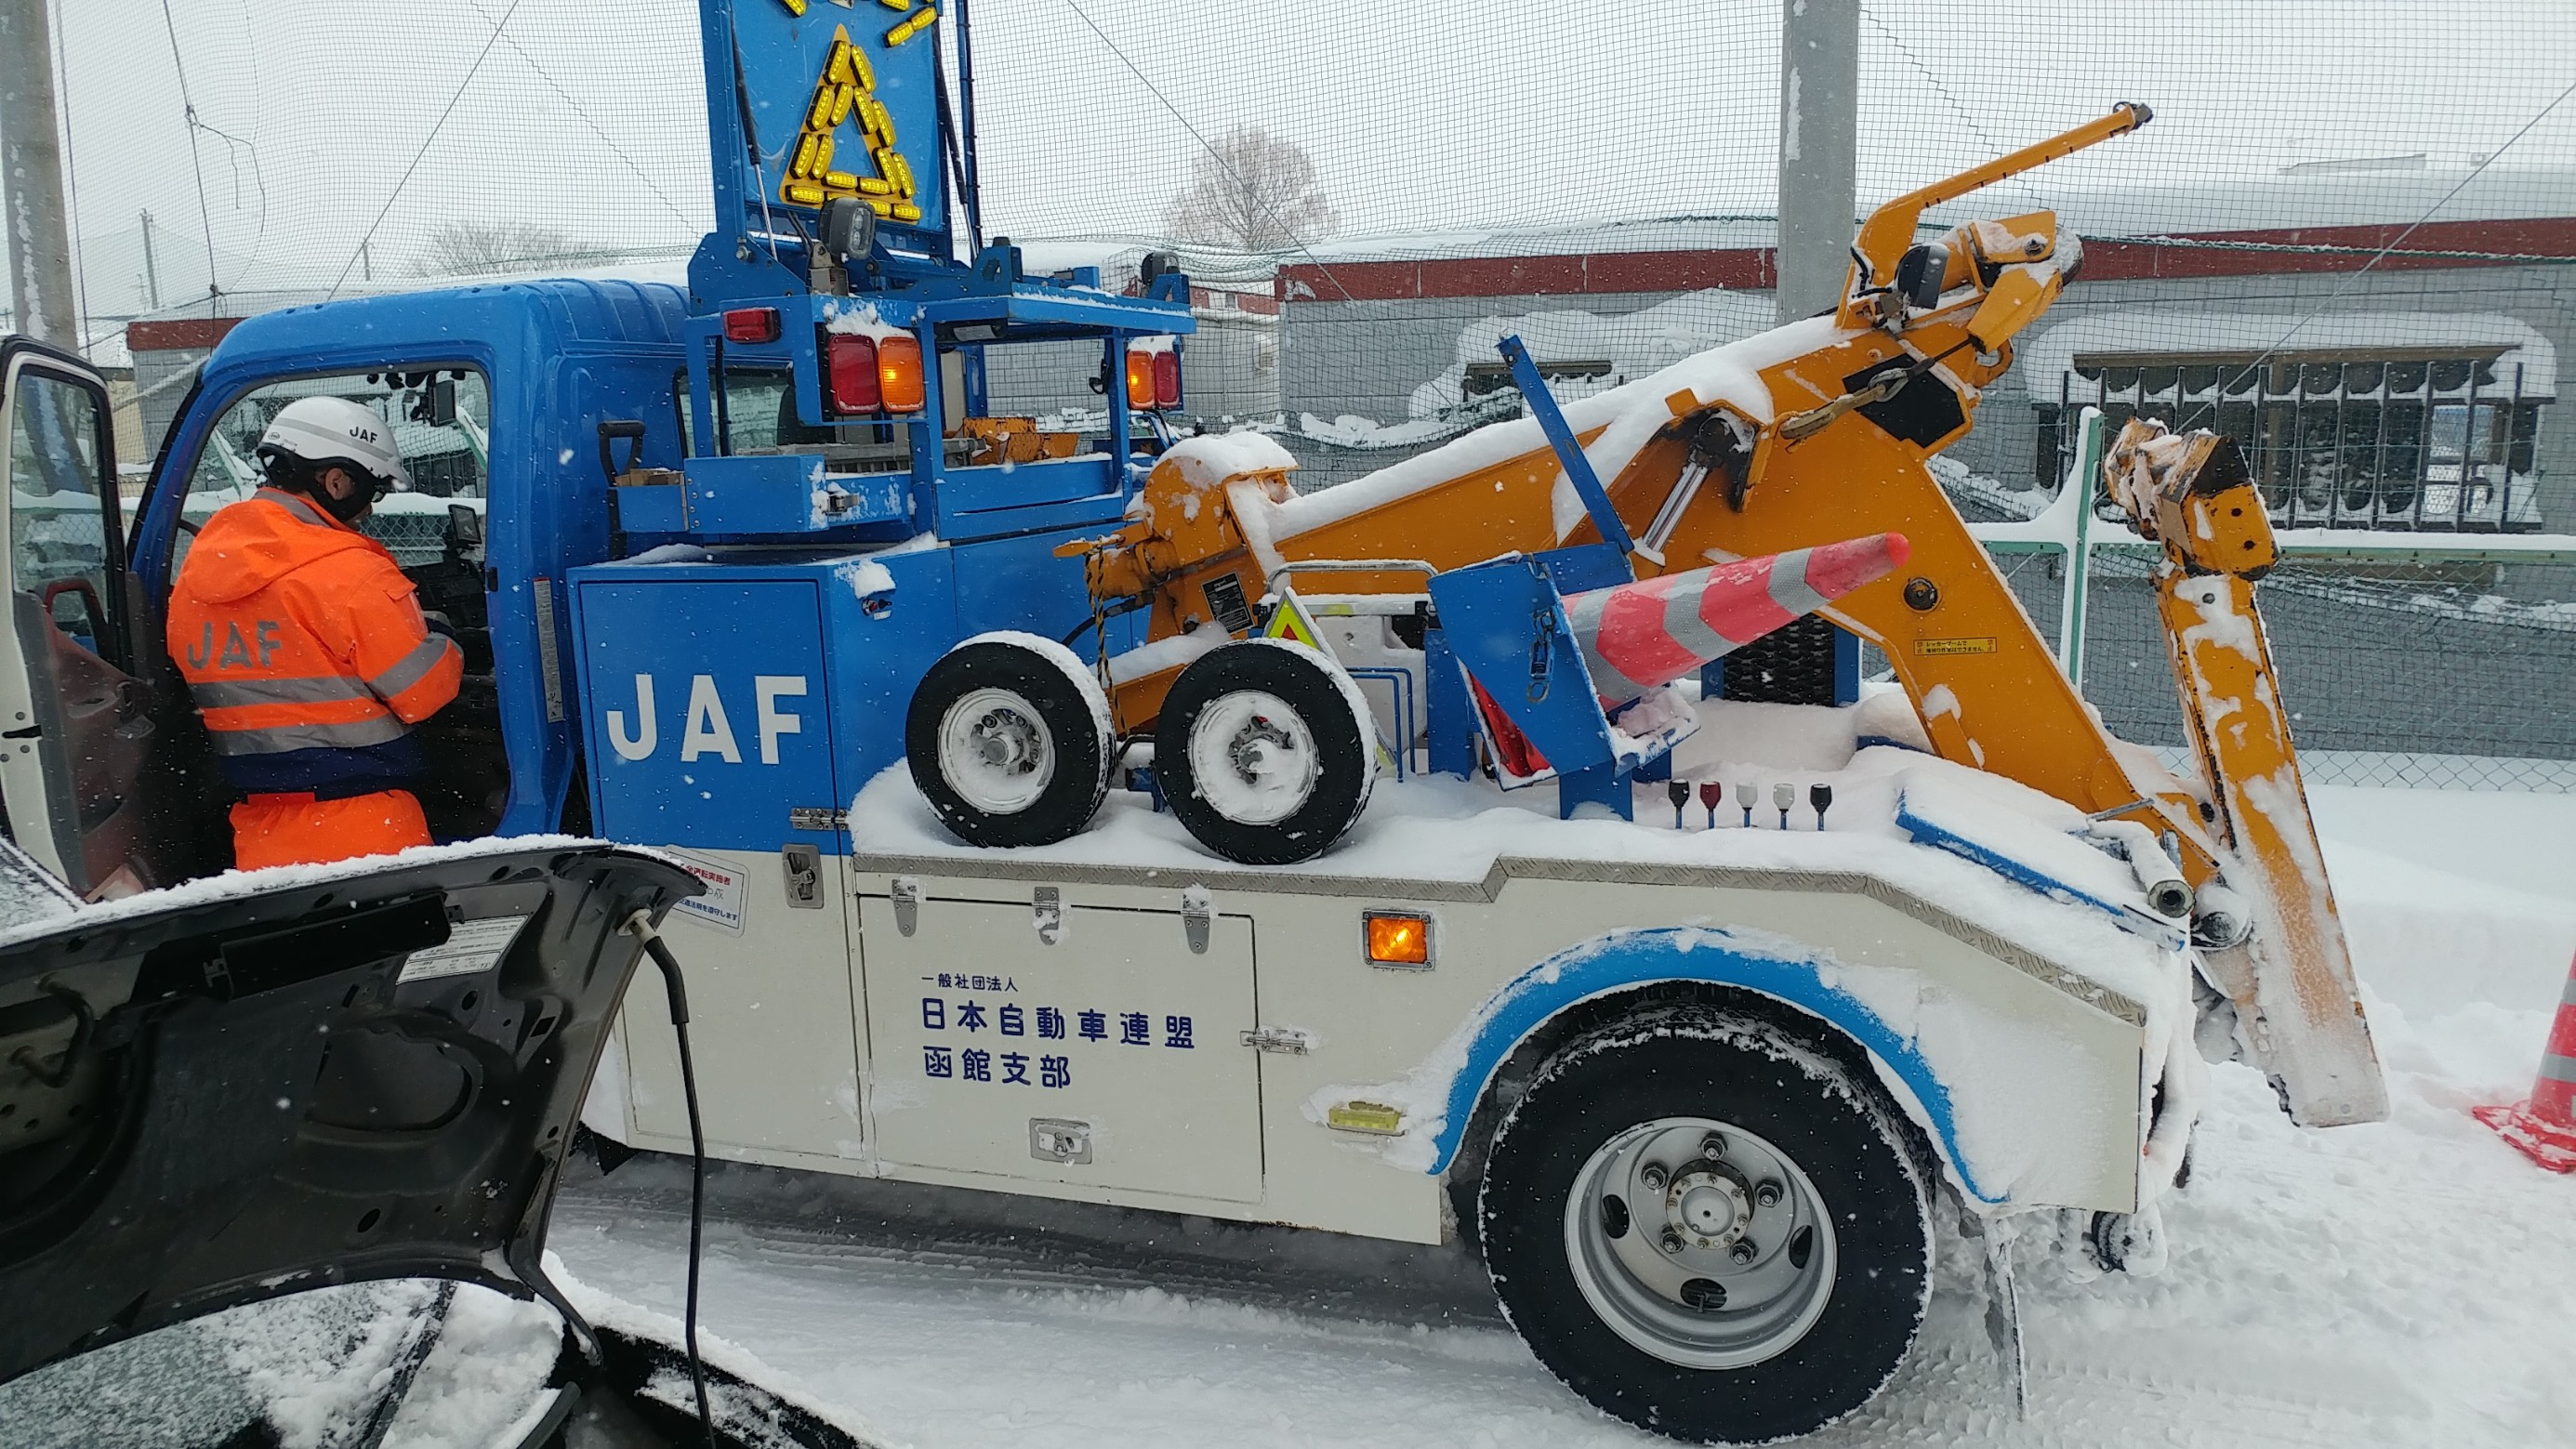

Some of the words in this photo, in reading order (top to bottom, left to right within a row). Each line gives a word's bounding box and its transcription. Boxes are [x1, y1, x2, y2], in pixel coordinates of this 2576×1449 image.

[350, 426, 378, 444] JAF
[188, 620, 283, 669] JAF
[606, 673, 808, 765] JAF
[685, 864, 731, 886] 全運転実施者
[921, 972, 1019, 993] 一般社団法人
[921, 997, 1196, 1049] 日本自動車連盟
[922, 1046, 1072, 1089] 函館支部
